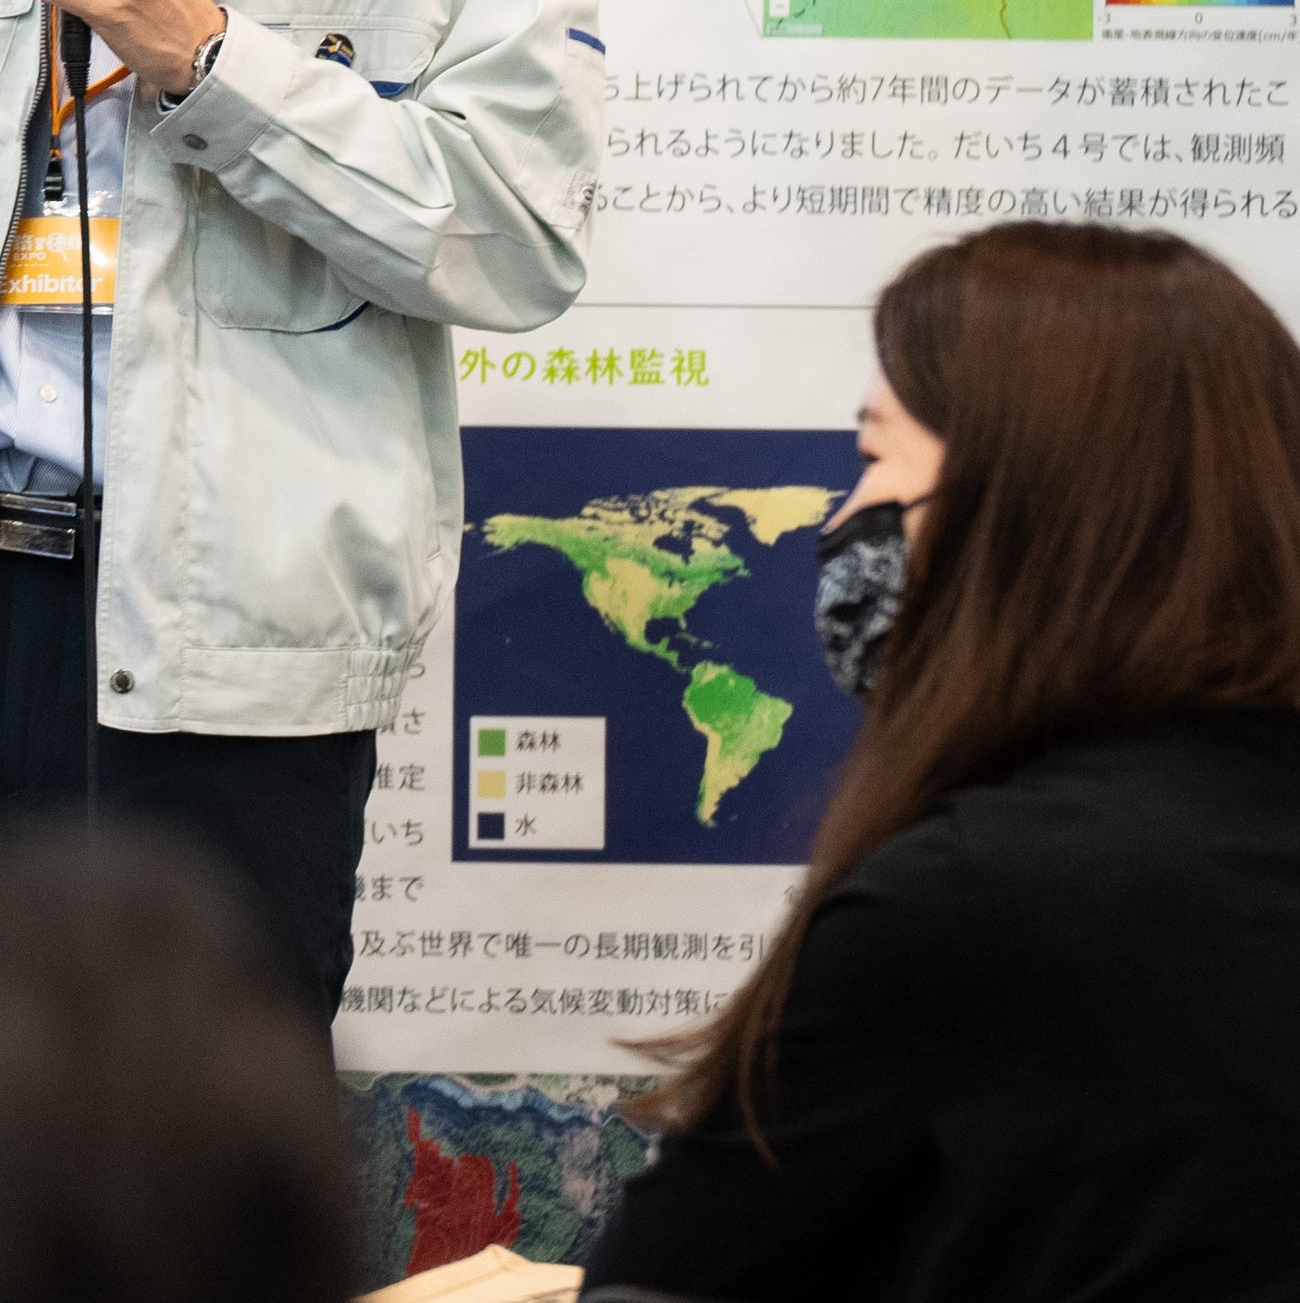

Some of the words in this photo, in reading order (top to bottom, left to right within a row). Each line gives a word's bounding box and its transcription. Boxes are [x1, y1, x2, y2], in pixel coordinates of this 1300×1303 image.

[459, 346, 710, 386] 外の森林監視
[515, 729, 561, 754] 森林
[515, 771, 584, 796] 非森林
[363, 819, 424, 846] いち
[514, 815, 538, 838] 水
